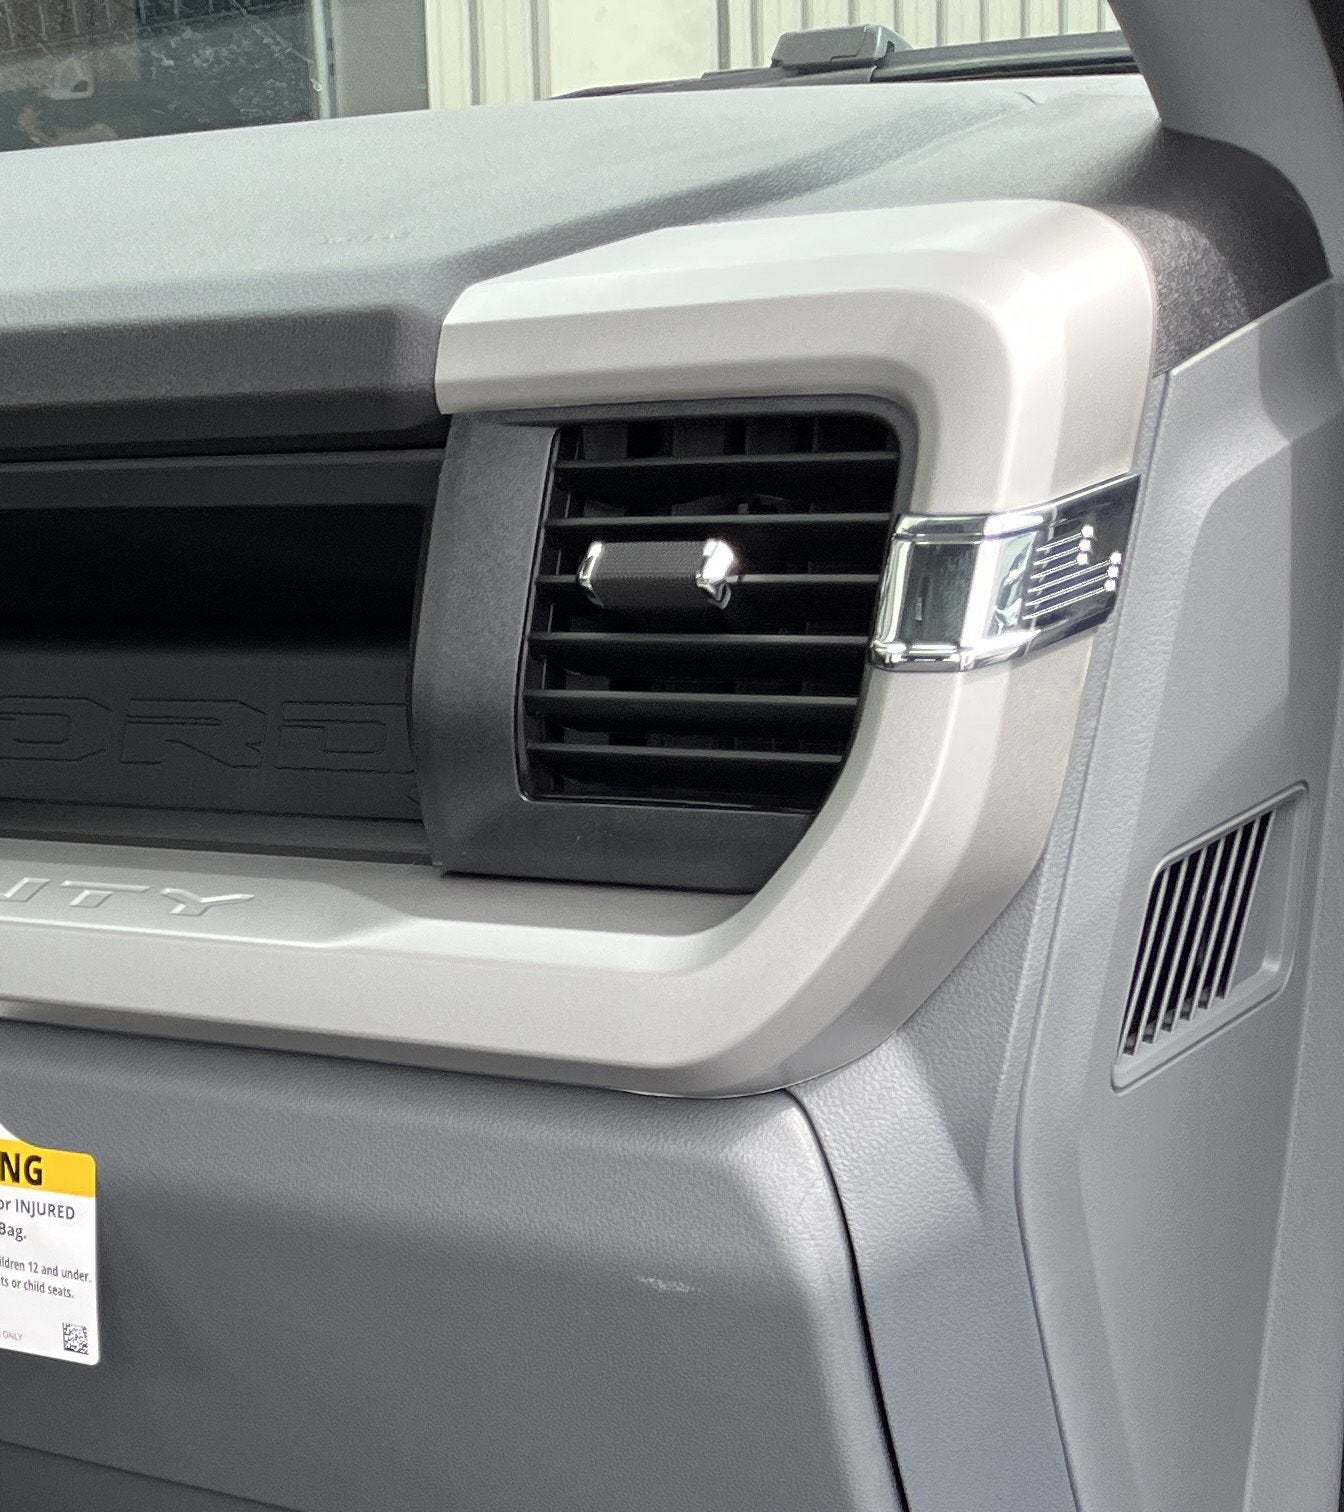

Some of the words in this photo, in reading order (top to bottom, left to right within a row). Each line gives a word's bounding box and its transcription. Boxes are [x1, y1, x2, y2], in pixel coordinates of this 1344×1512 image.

[15, 1199, 75, 1220] INJURED
[28, 1261, 39, 1274] 12
[41, 1265, 59, 1278] and
[61, 1269, 92, 1284] under.
[11, 1279, 22, 1289] or
[23, 1278, 46, 1294] child
[47, 1284, 75, 1299] seats.
[2, 1330, 23, 1342] ONLY
